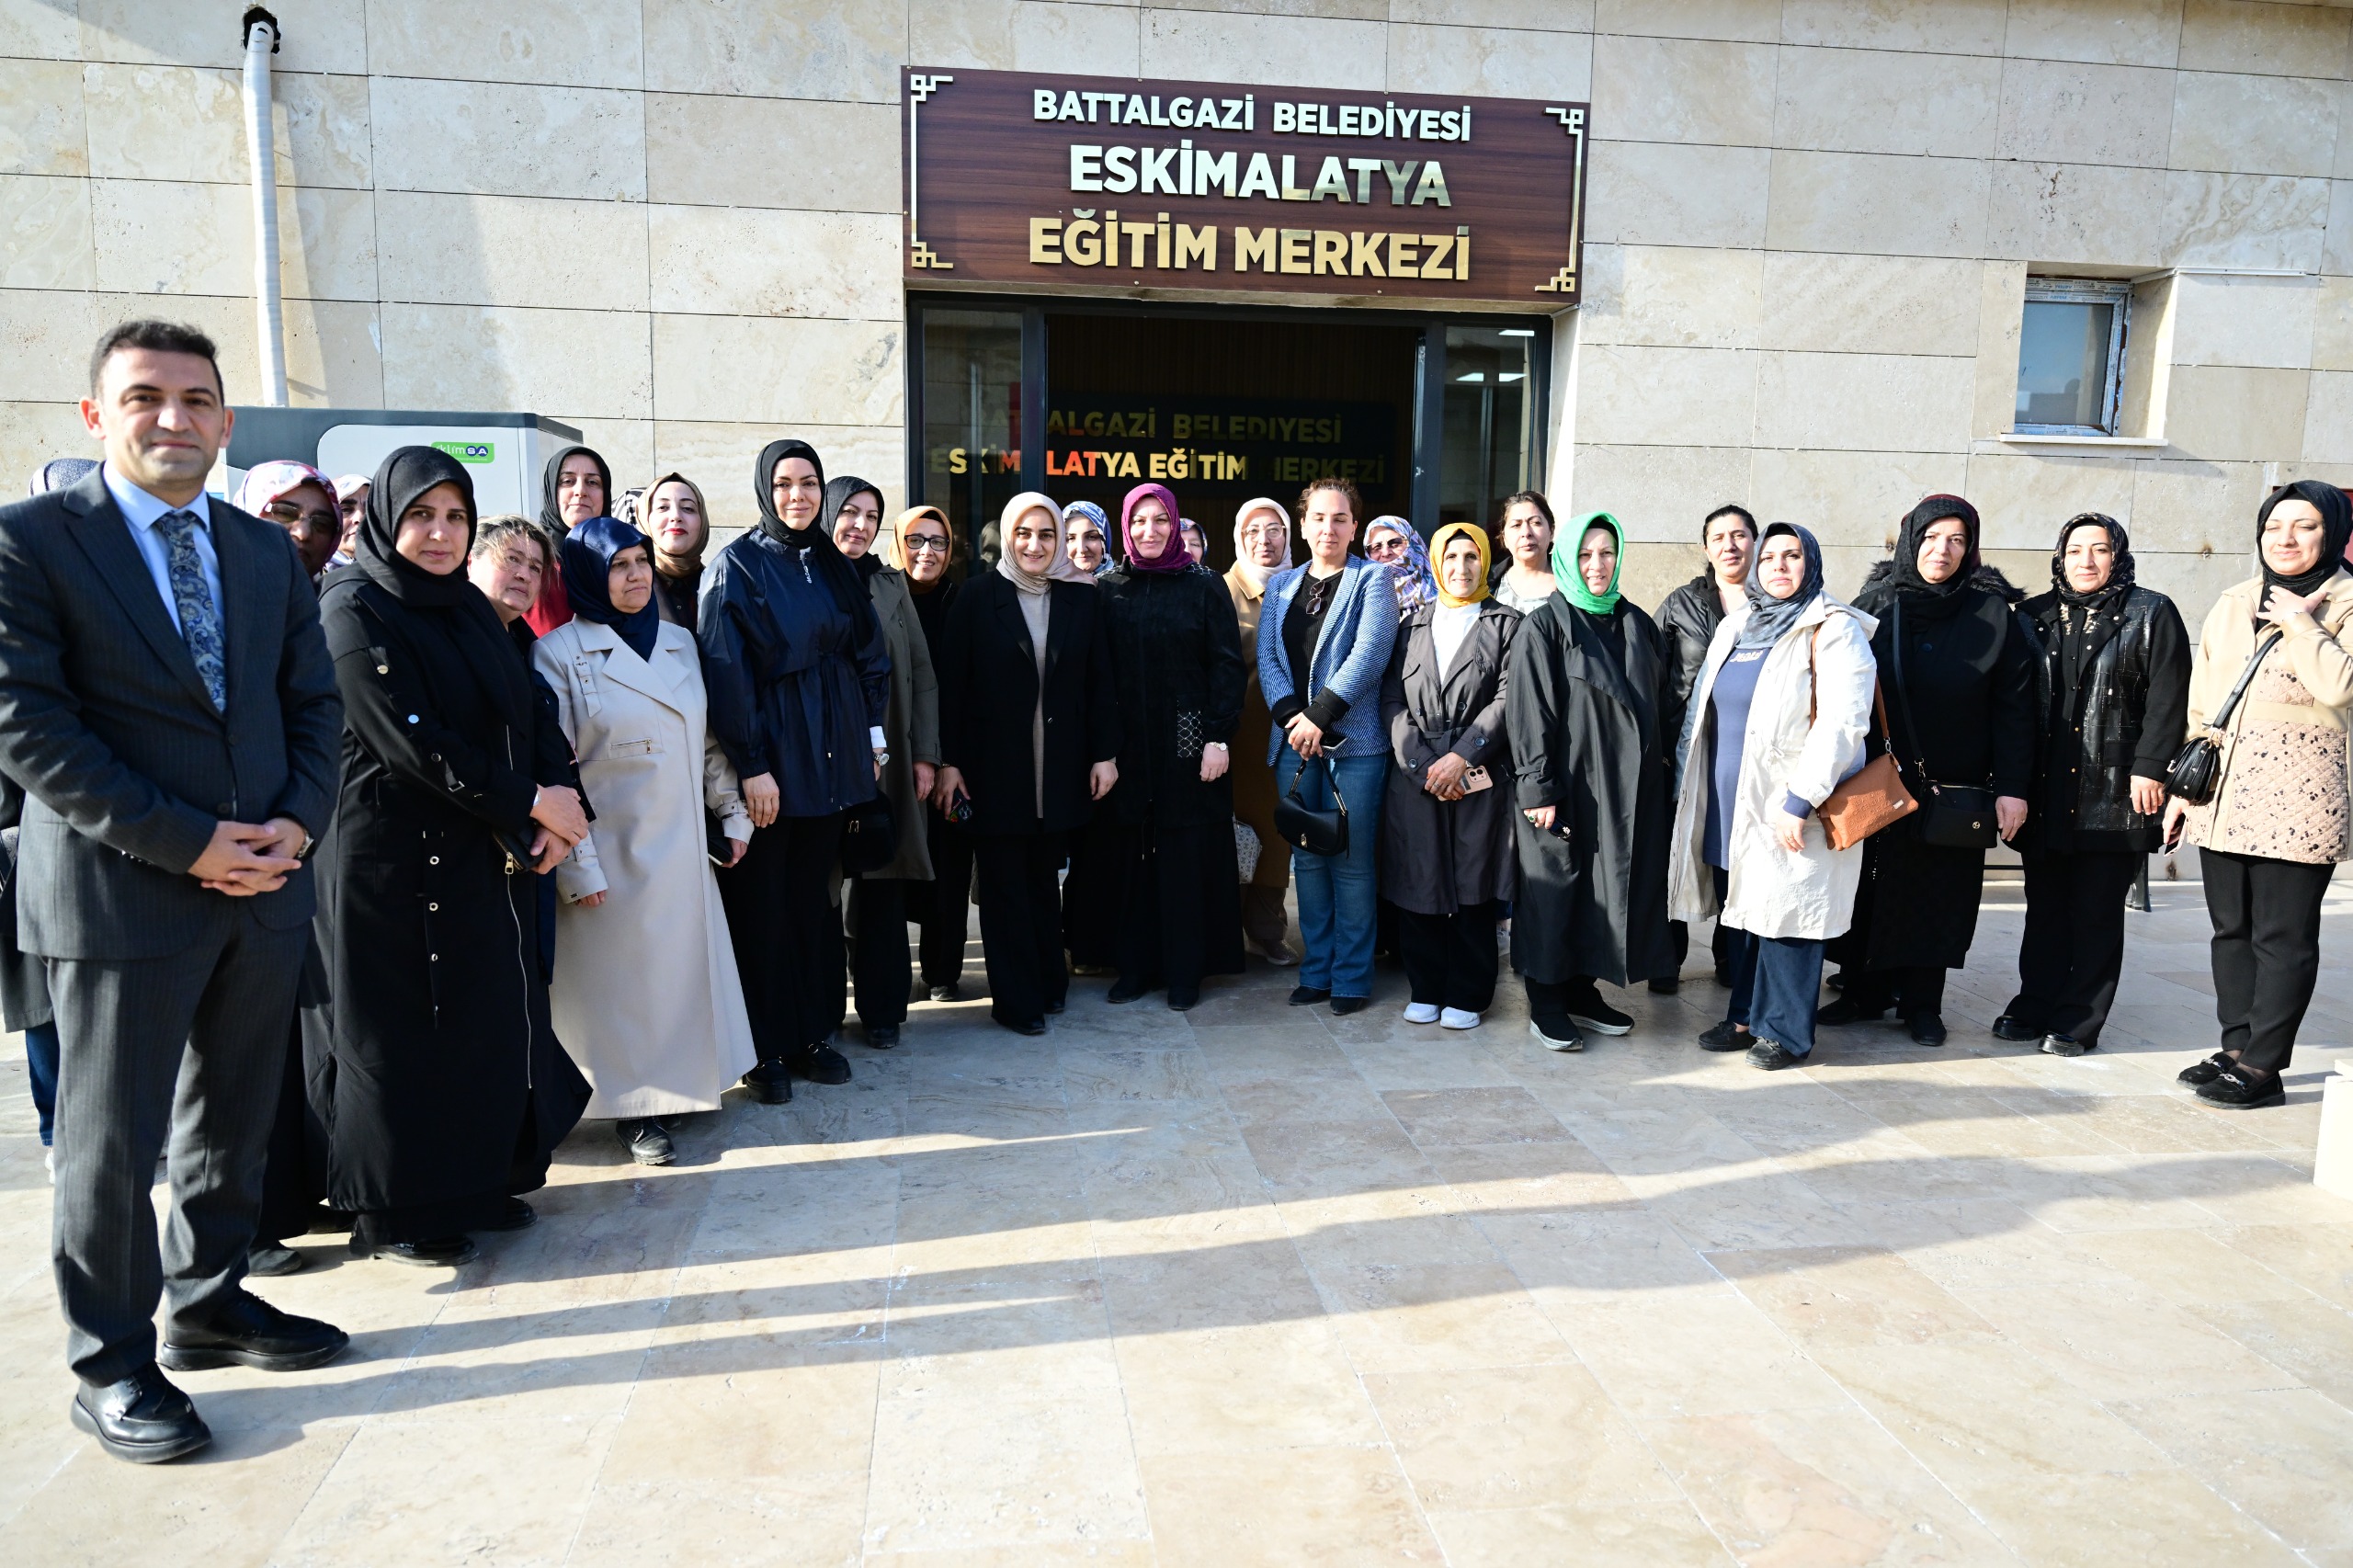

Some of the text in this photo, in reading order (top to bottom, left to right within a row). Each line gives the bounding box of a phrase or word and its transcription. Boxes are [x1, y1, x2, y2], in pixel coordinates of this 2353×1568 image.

[1034, 89, 1471, 142] BATTALGAZİ BELEDİYESİ
[1070, 139, 1452, 207] ESKİMALATYA
[1029, 208, 1470, 280] EĞİTİM MERKEZİ
[930, 443, 1142, 478] ESİMLATYA
[1149, 447, 1249, 482] EĞİTİM
